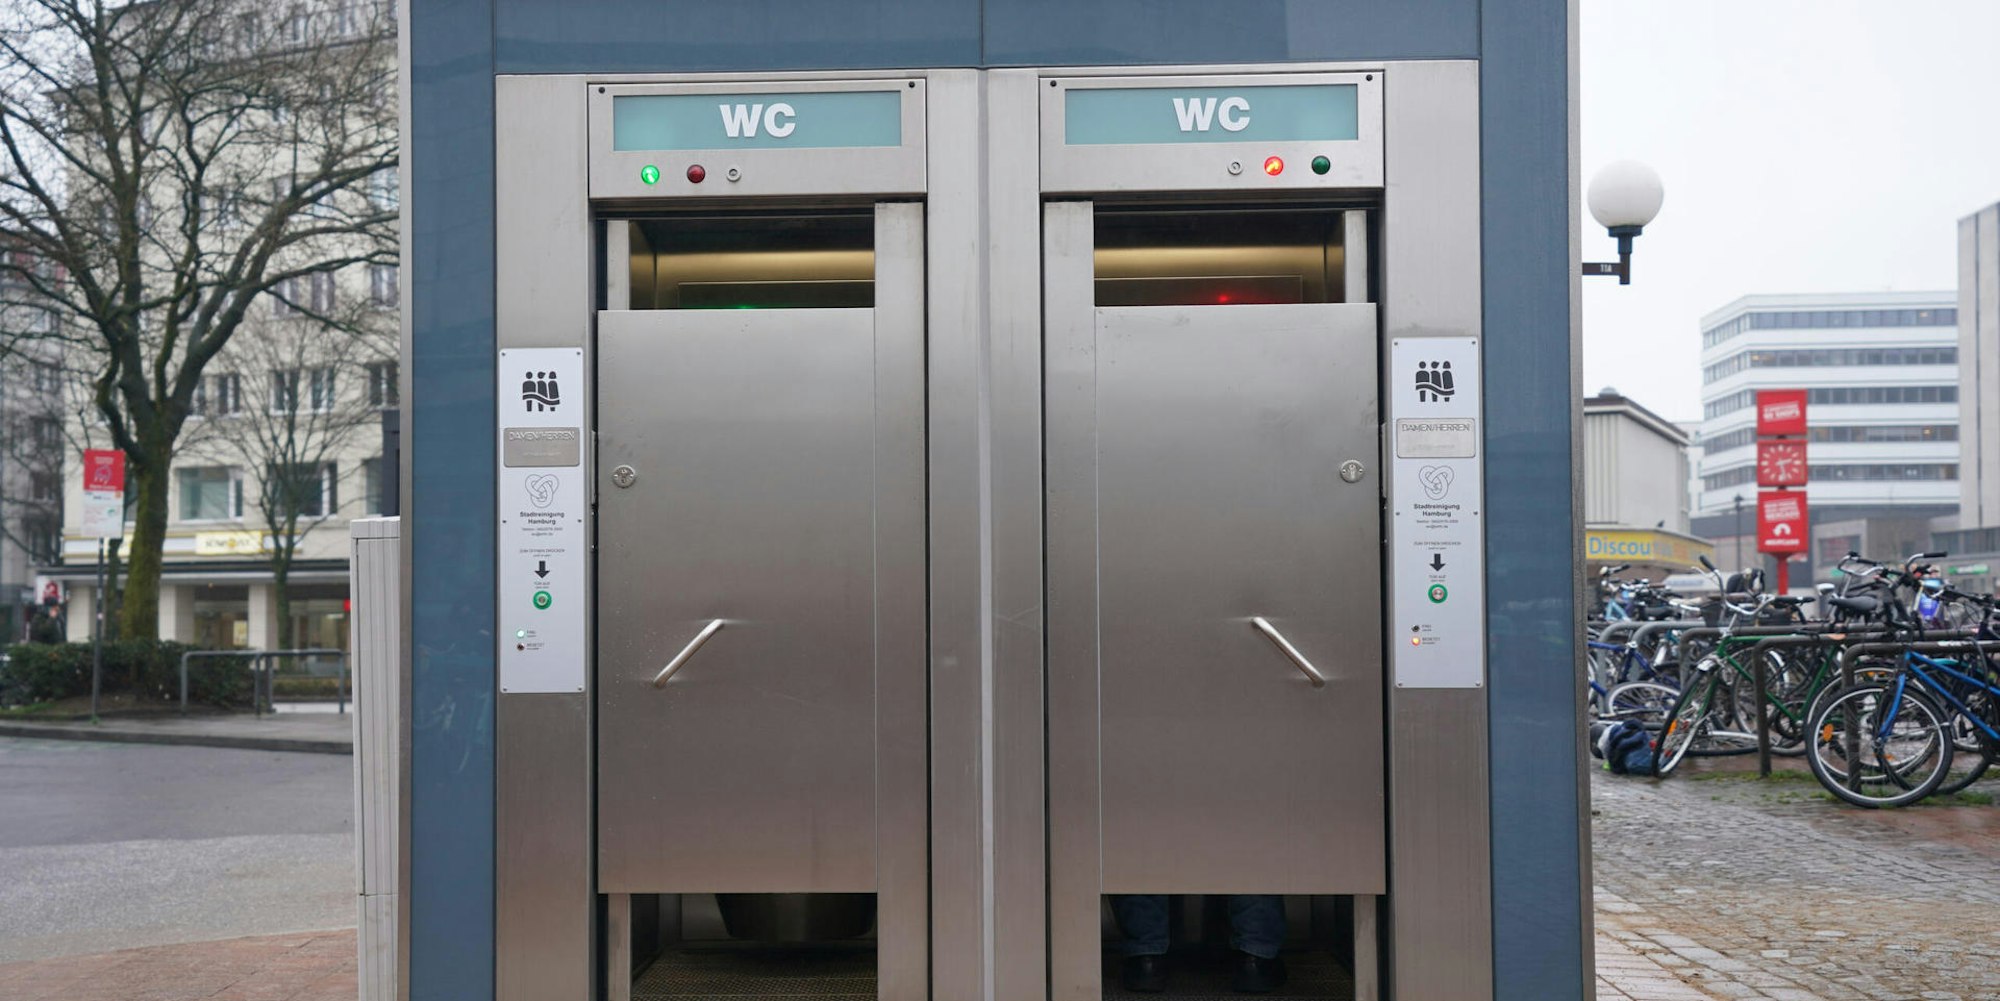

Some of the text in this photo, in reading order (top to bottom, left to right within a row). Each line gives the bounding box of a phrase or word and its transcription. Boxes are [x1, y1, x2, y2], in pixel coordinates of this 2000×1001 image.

[719, 102, 796, 138] WC
[1173, 96, 1250, 132] WC
[508, 431, 575, 441] DAMEN/HERREN
[1402, 423, 1470, 432] DAMEN/HERREN
